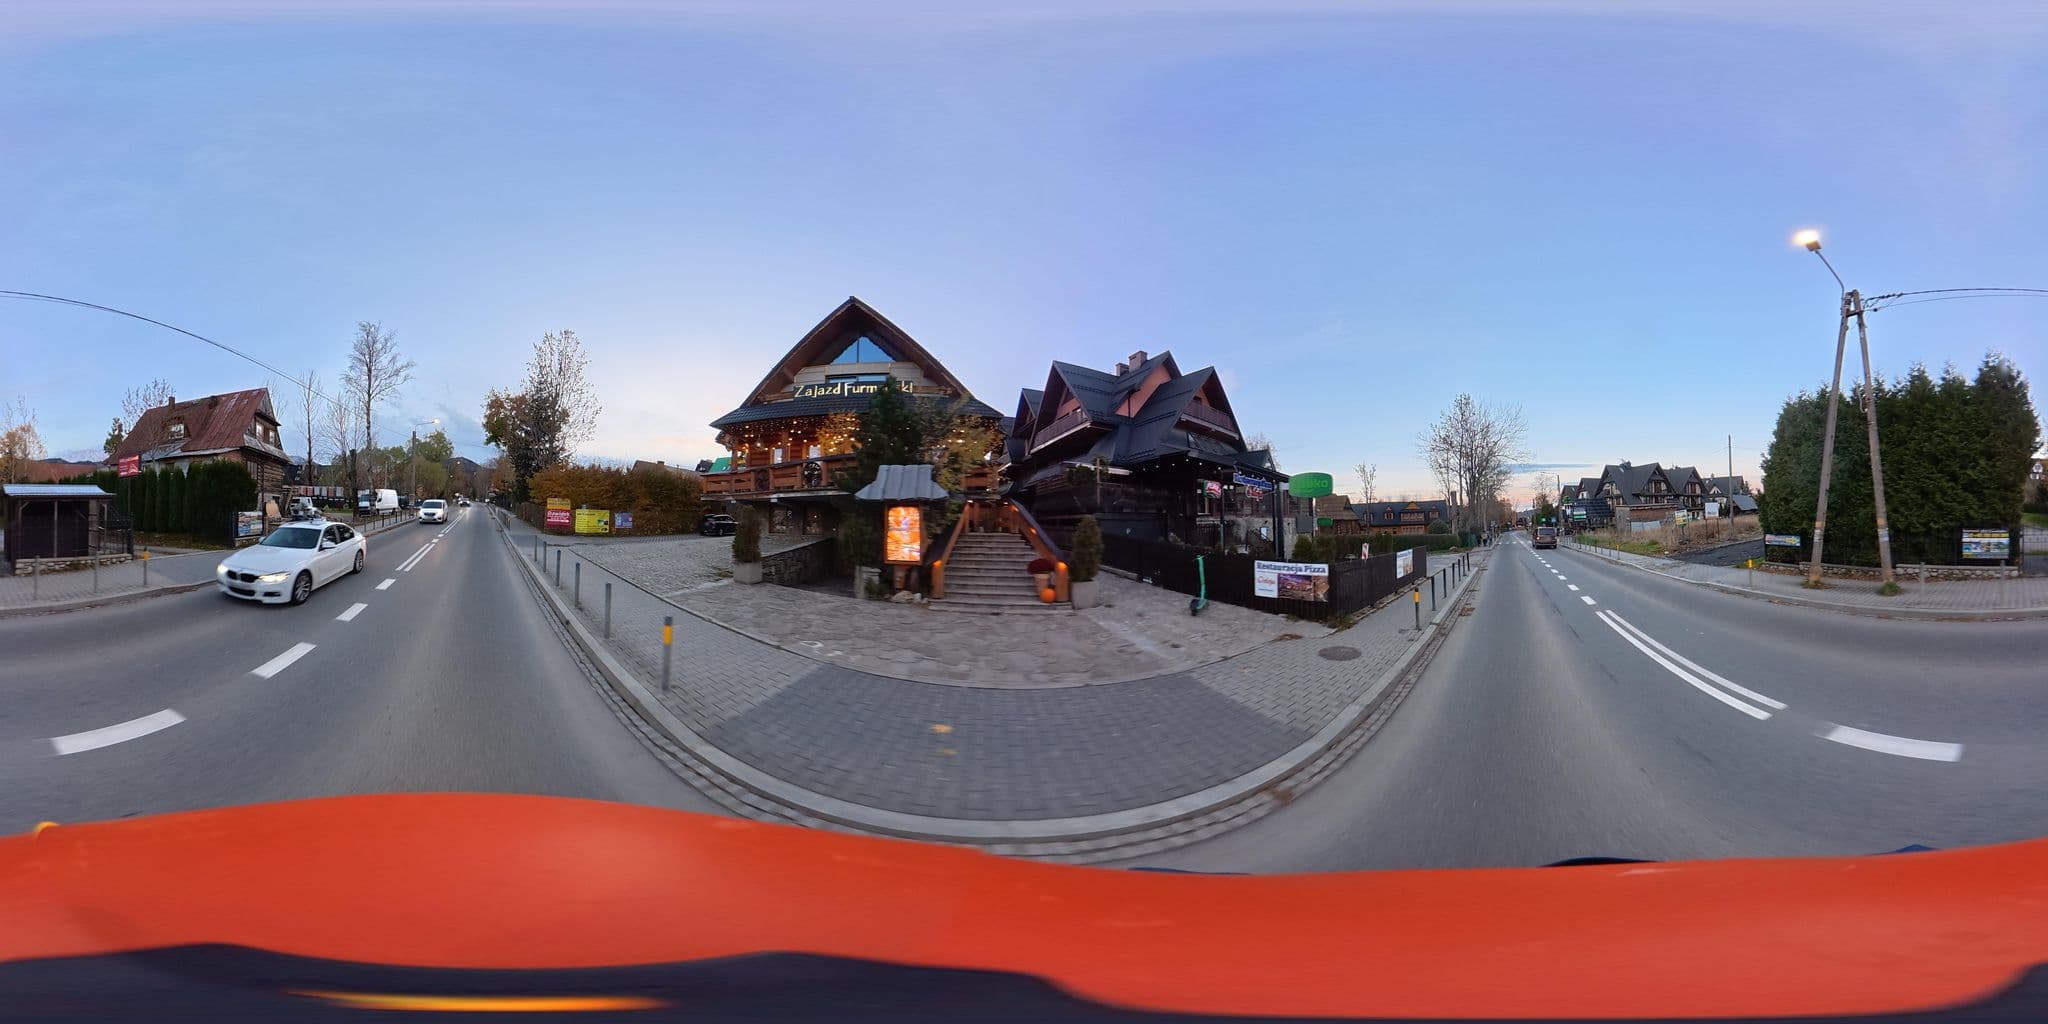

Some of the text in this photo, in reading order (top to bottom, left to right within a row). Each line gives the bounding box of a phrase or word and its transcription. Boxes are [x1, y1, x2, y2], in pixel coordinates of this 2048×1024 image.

[794, 382, 841, 398] Zajazd
[1256, 562, 1326, 574] Restauracja Pizza
